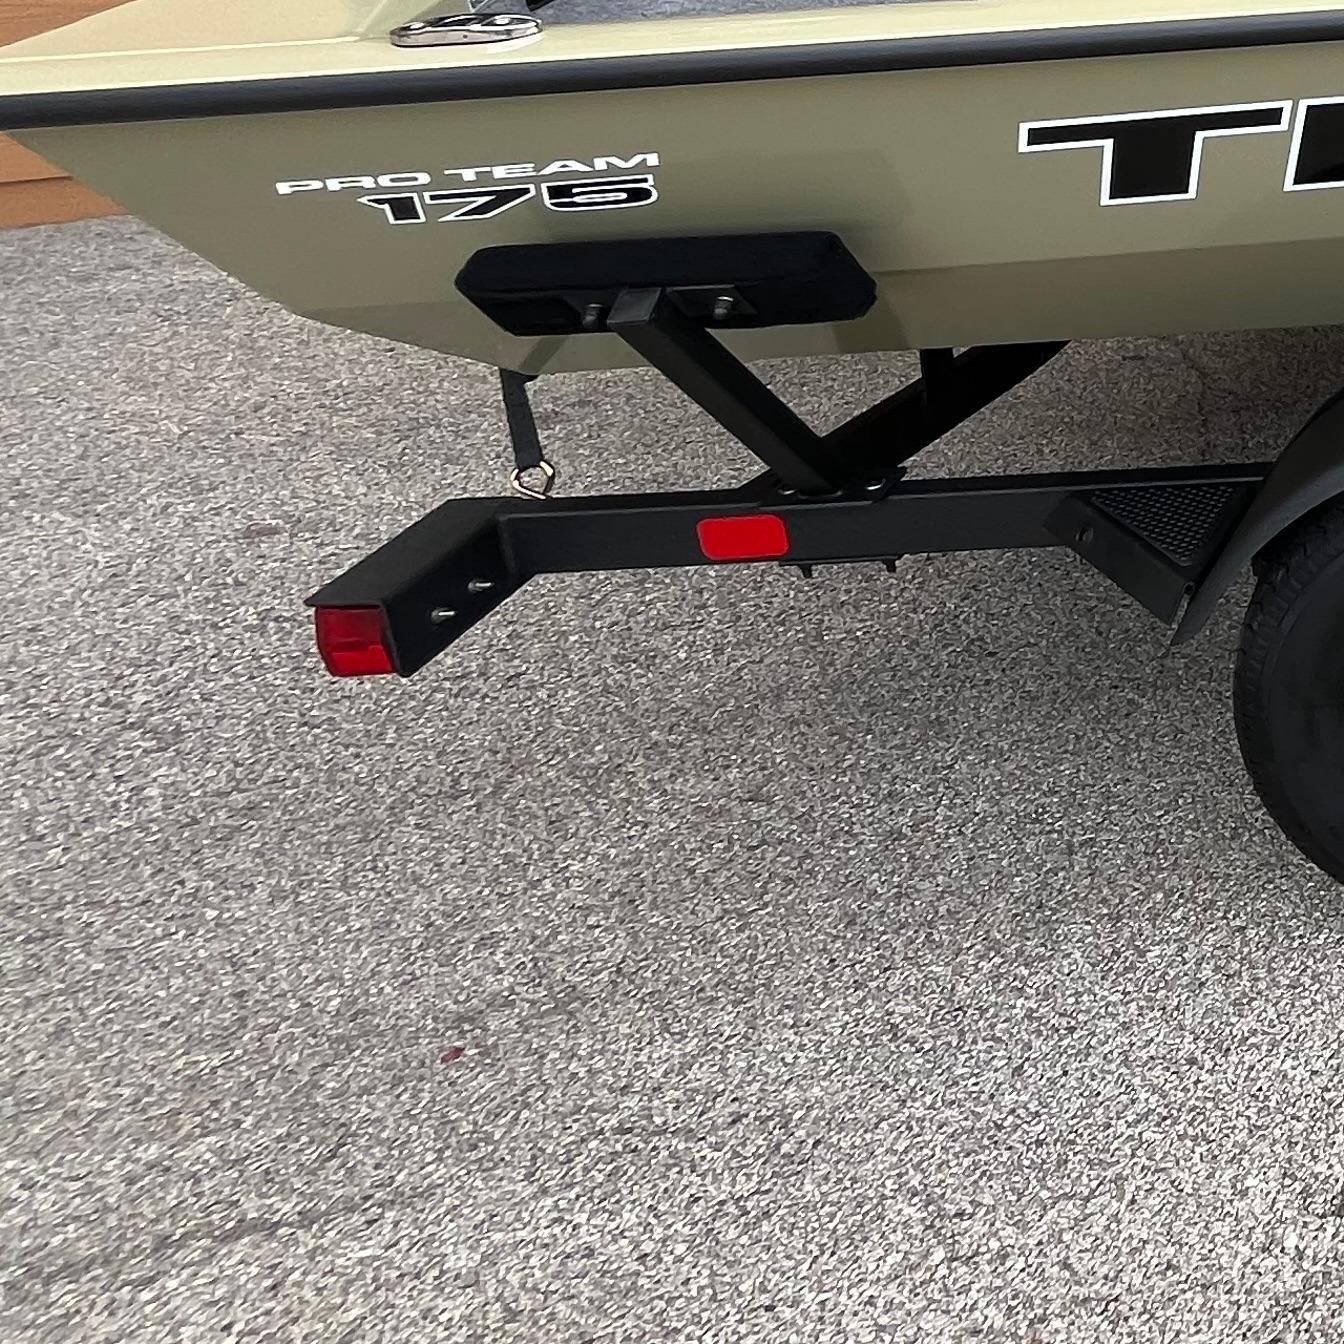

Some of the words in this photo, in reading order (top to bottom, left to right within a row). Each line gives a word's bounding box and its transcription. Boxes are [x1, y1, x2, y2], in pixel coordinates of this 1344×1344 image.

[275, 171, 432, 196] PRO
[443, 152, 660, 182] TEAM
[356, 173, 659, 225] 175
